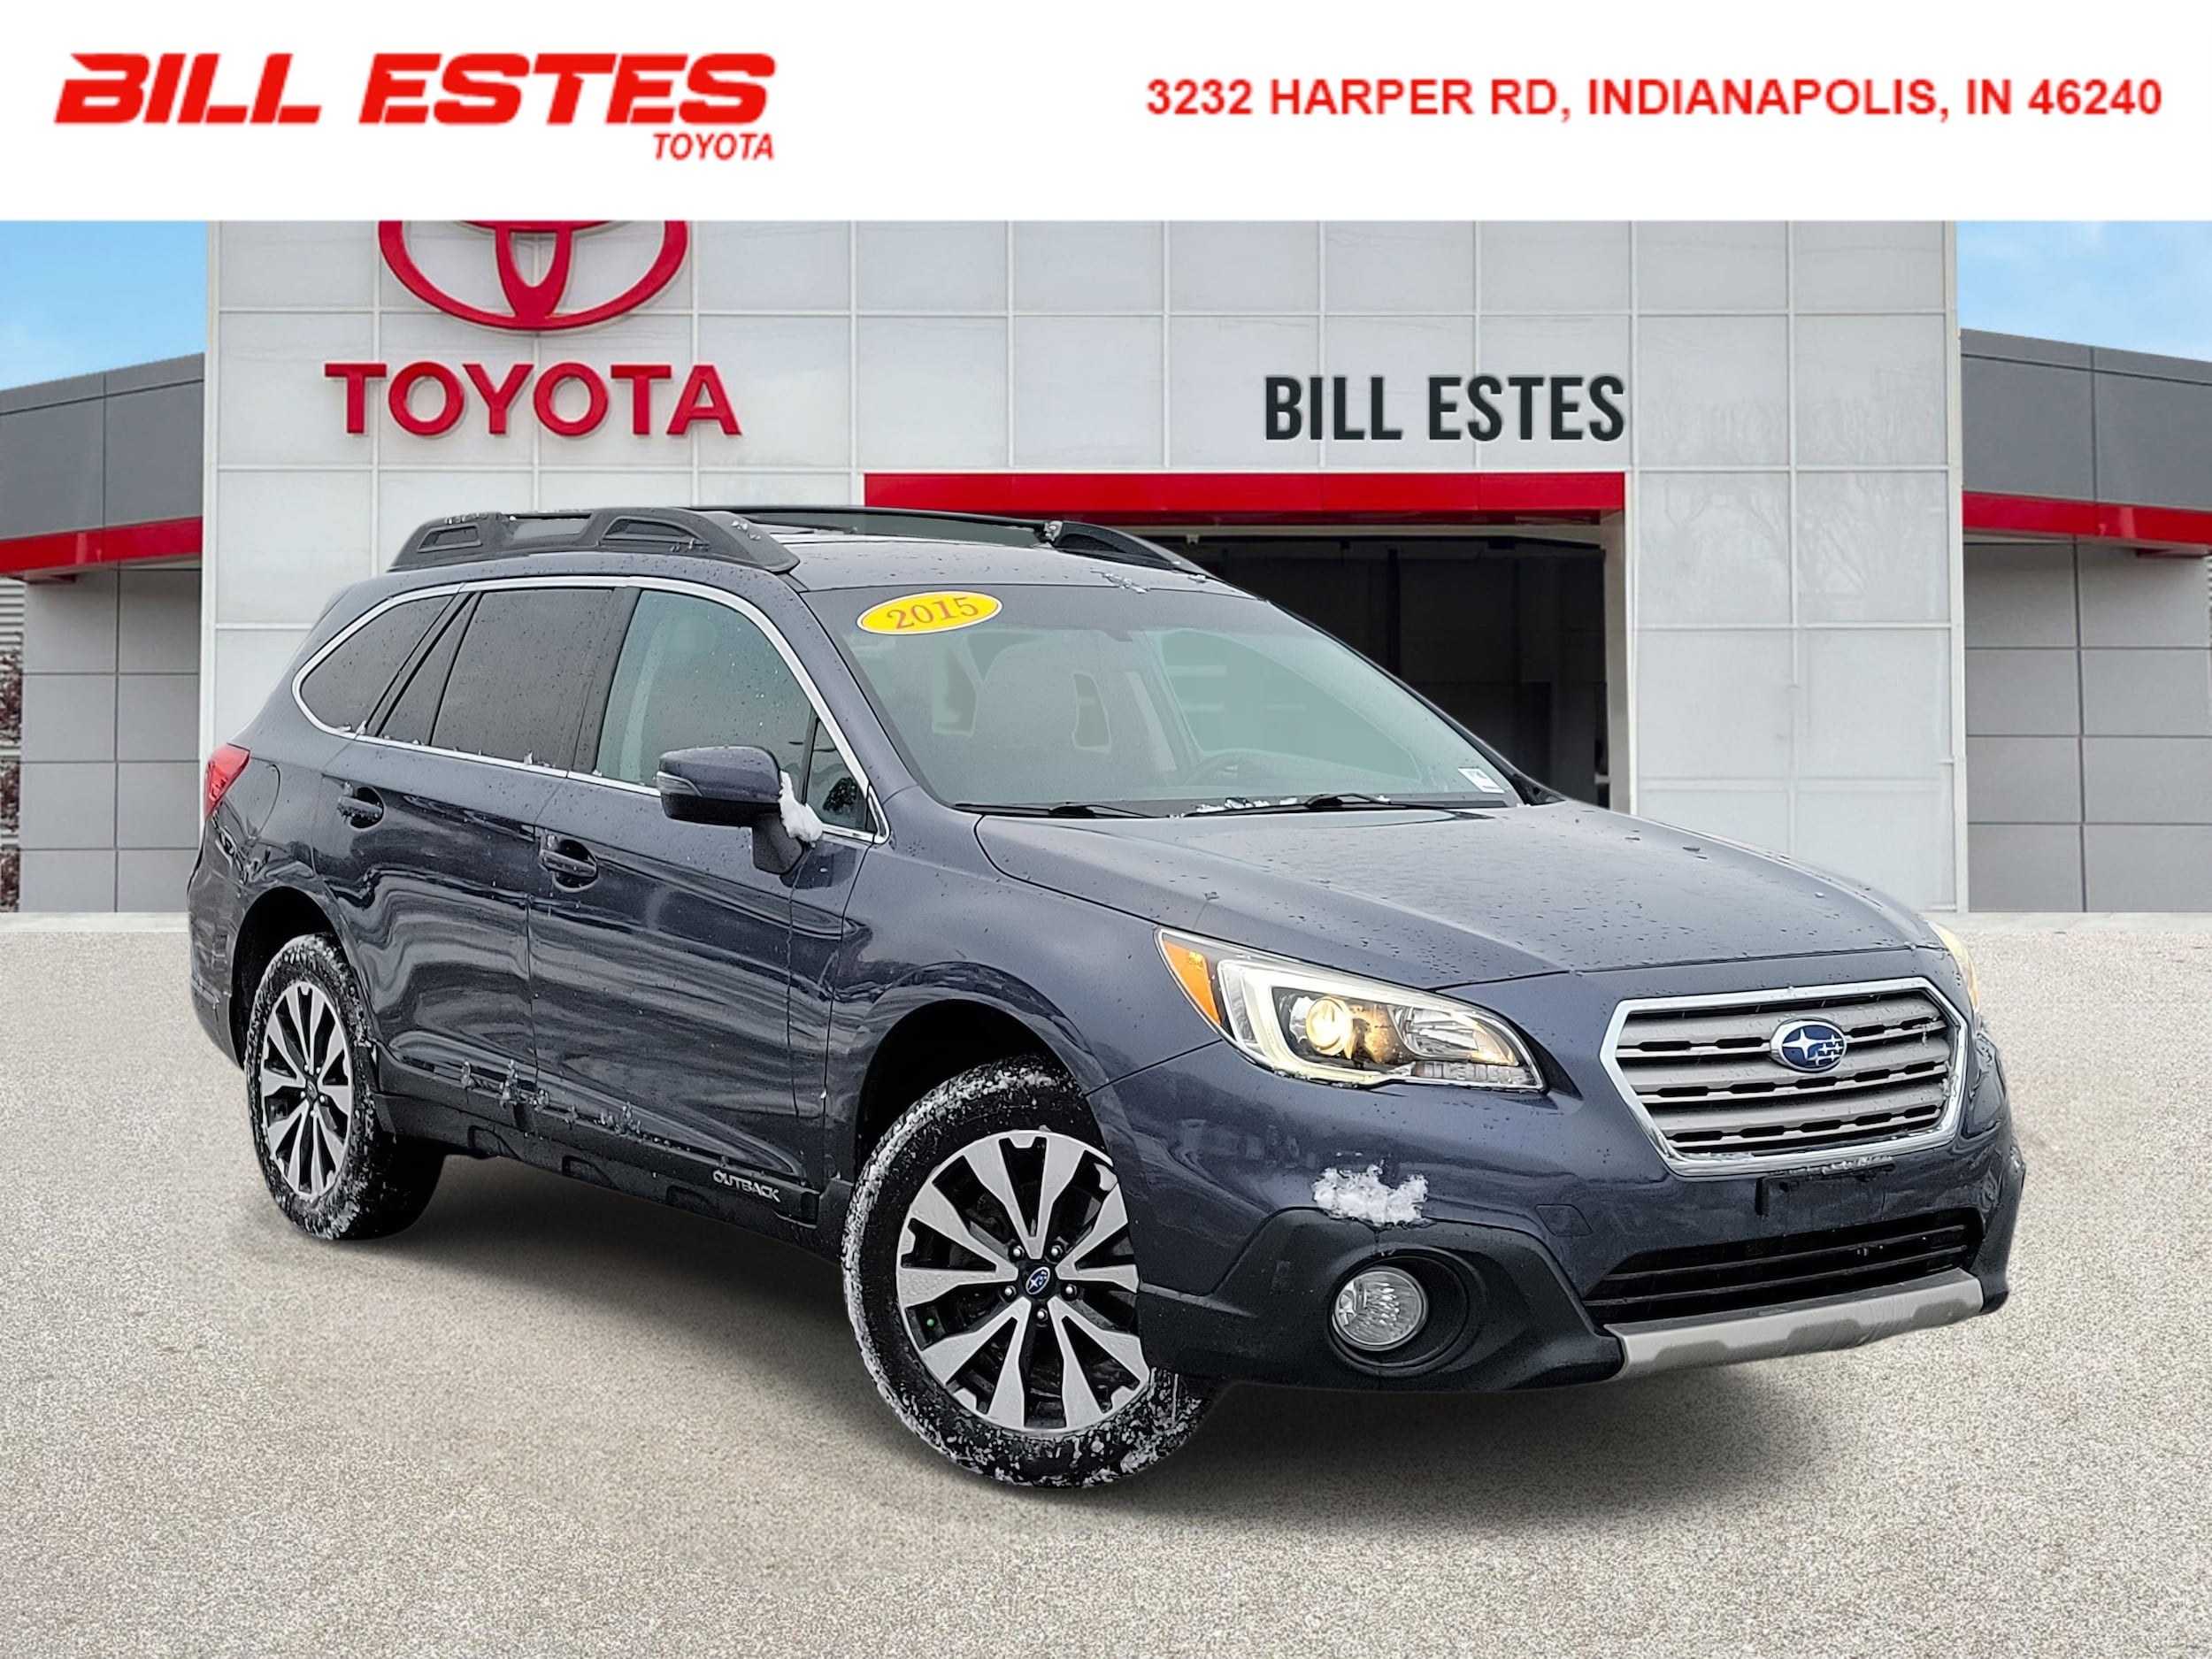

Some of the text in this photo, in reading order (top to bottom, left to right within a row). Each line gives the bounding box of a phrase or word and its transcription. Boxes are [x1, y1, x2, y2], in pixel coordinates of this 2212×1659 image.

[325, 361, 741, 437] TOYOTA
[1265, 374, 1625, 442] BILL ESTES
[887, 596, 979, 630] 2015
[712, 1169, 780, 1203] OUTBACK
